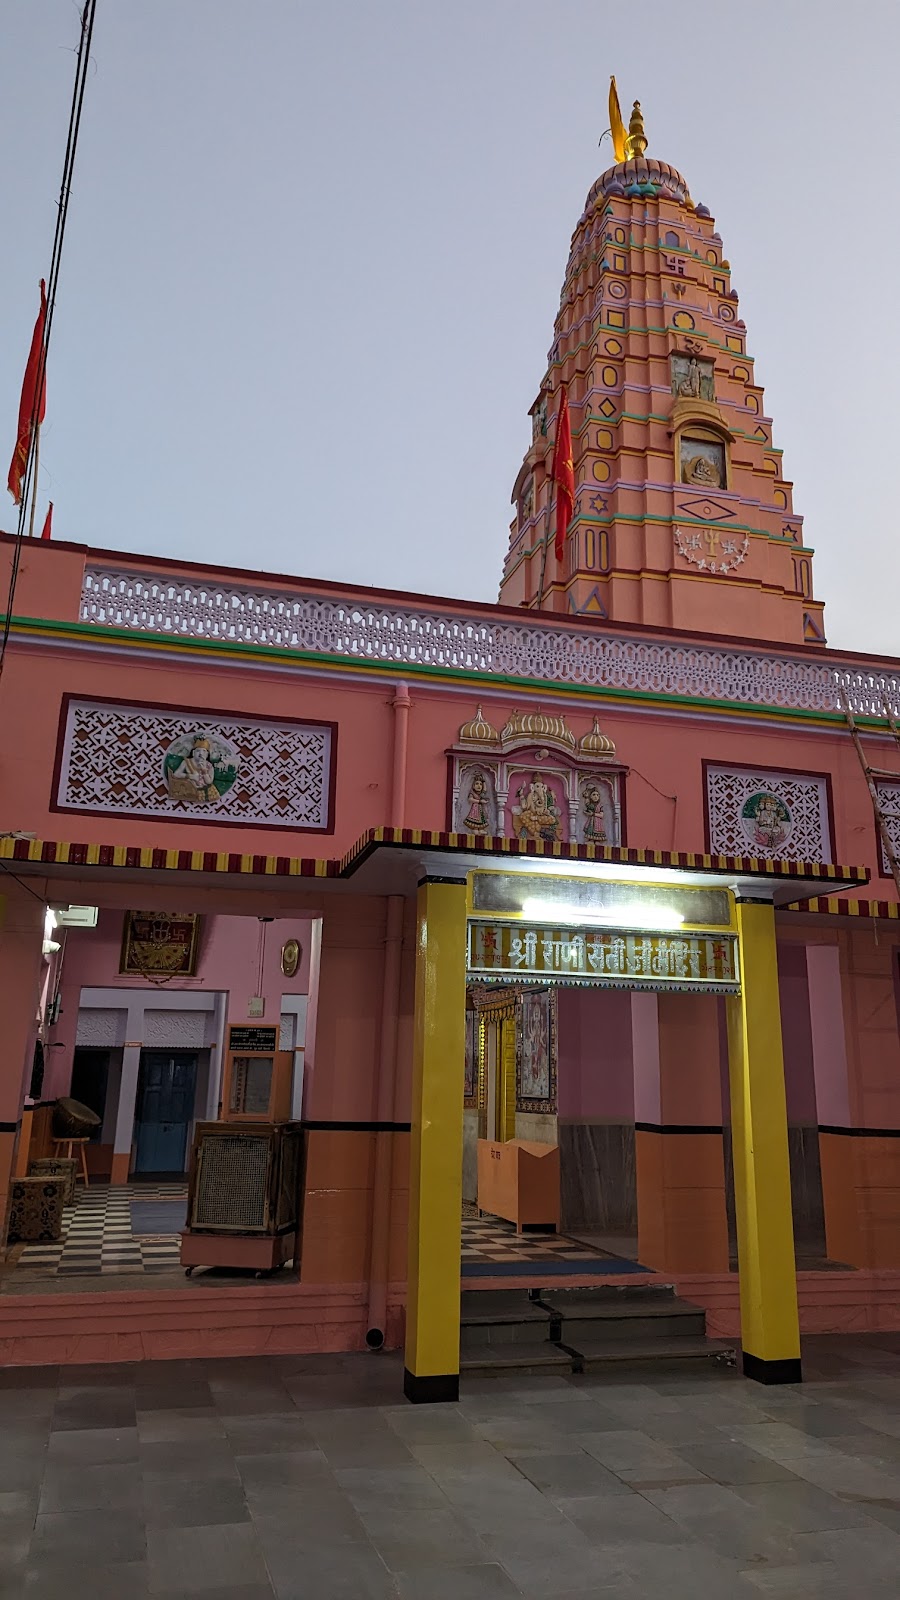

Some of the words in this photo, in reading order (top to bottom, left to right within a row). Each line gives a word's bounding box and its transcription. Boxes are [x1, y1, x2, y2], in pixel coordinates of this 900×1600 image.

[508, 931, 537, 965] श्री
[541, 935, 585, 968] राणी
[587, 938, 626, 971] सती
[626, 939, 653, 972] जी
[651, 940, 702, 976] मंदिर
